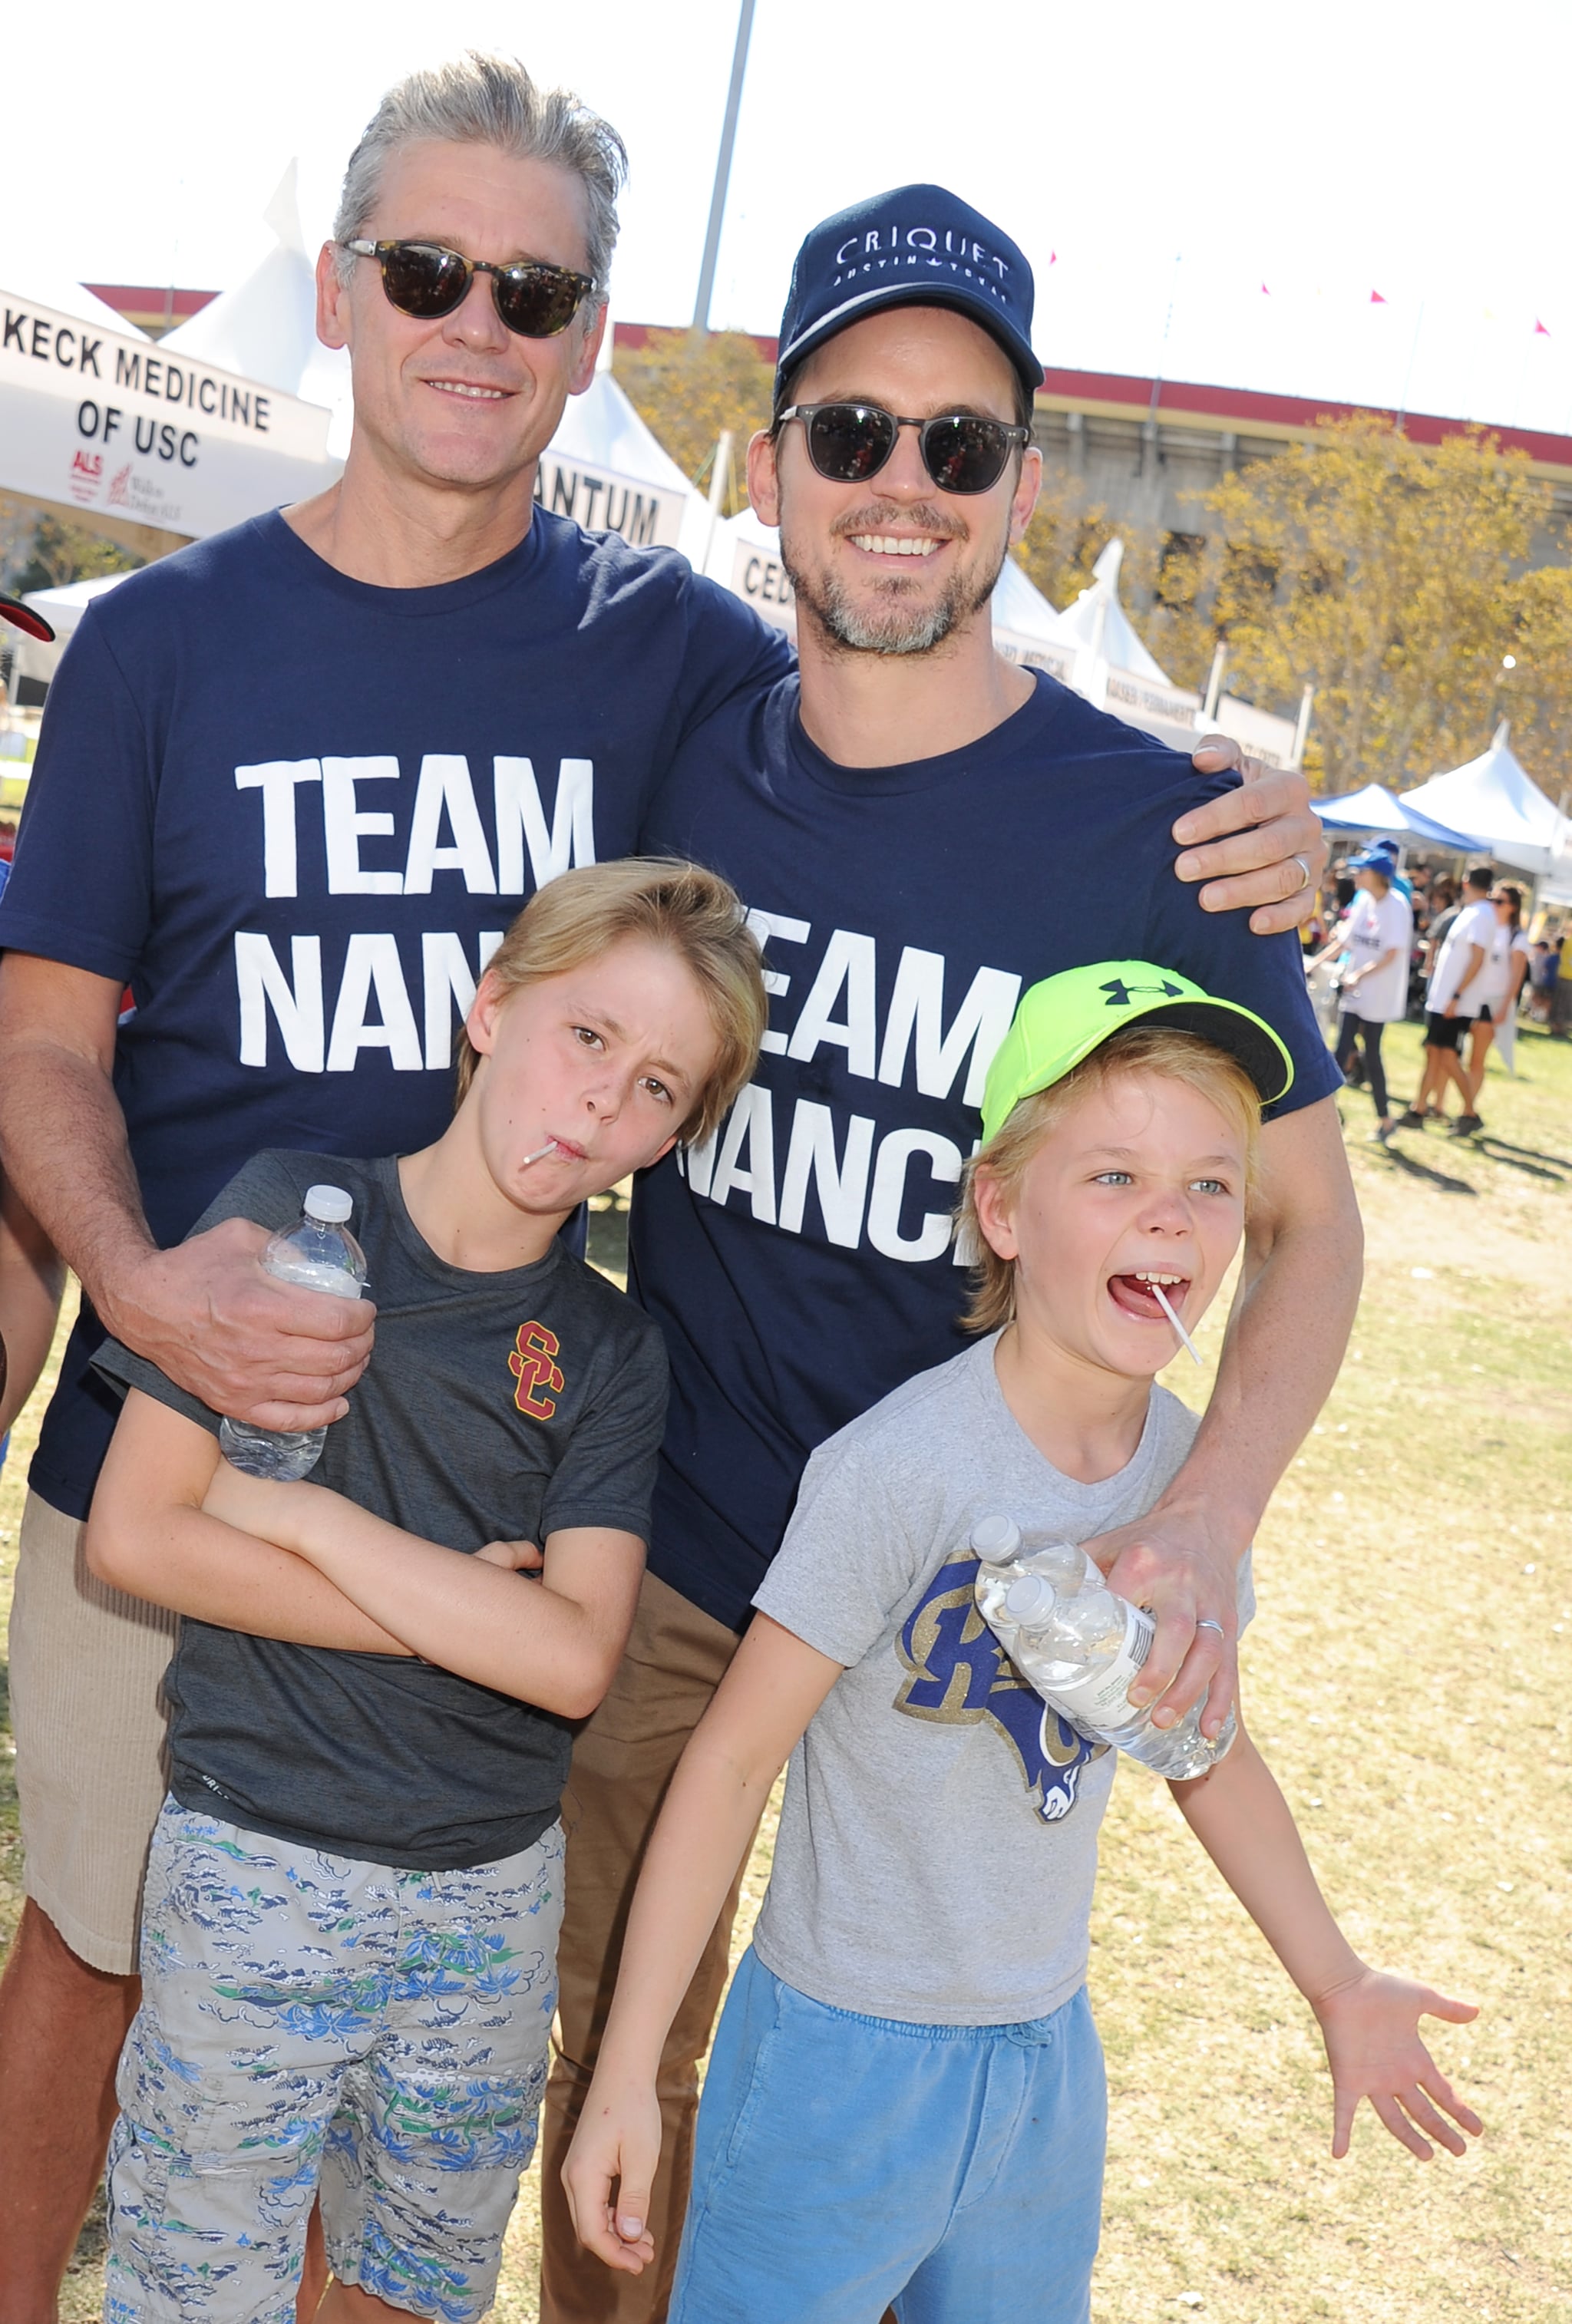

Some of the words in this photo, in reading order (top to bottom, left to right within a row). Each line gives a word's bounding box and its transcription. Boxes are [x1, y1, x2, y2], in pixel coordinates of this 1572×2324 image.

[3, 309, 103, 378] KECK
[115, 348, 270, 432] MEDICINE
[78, 400, 122, 443] OF
[134, 415, 200, 467] USC
[235, 754, 596, 898] TEAM
[234, 930, 504, 1074] NAN
[732, 903, 1022, 1109] EAM
